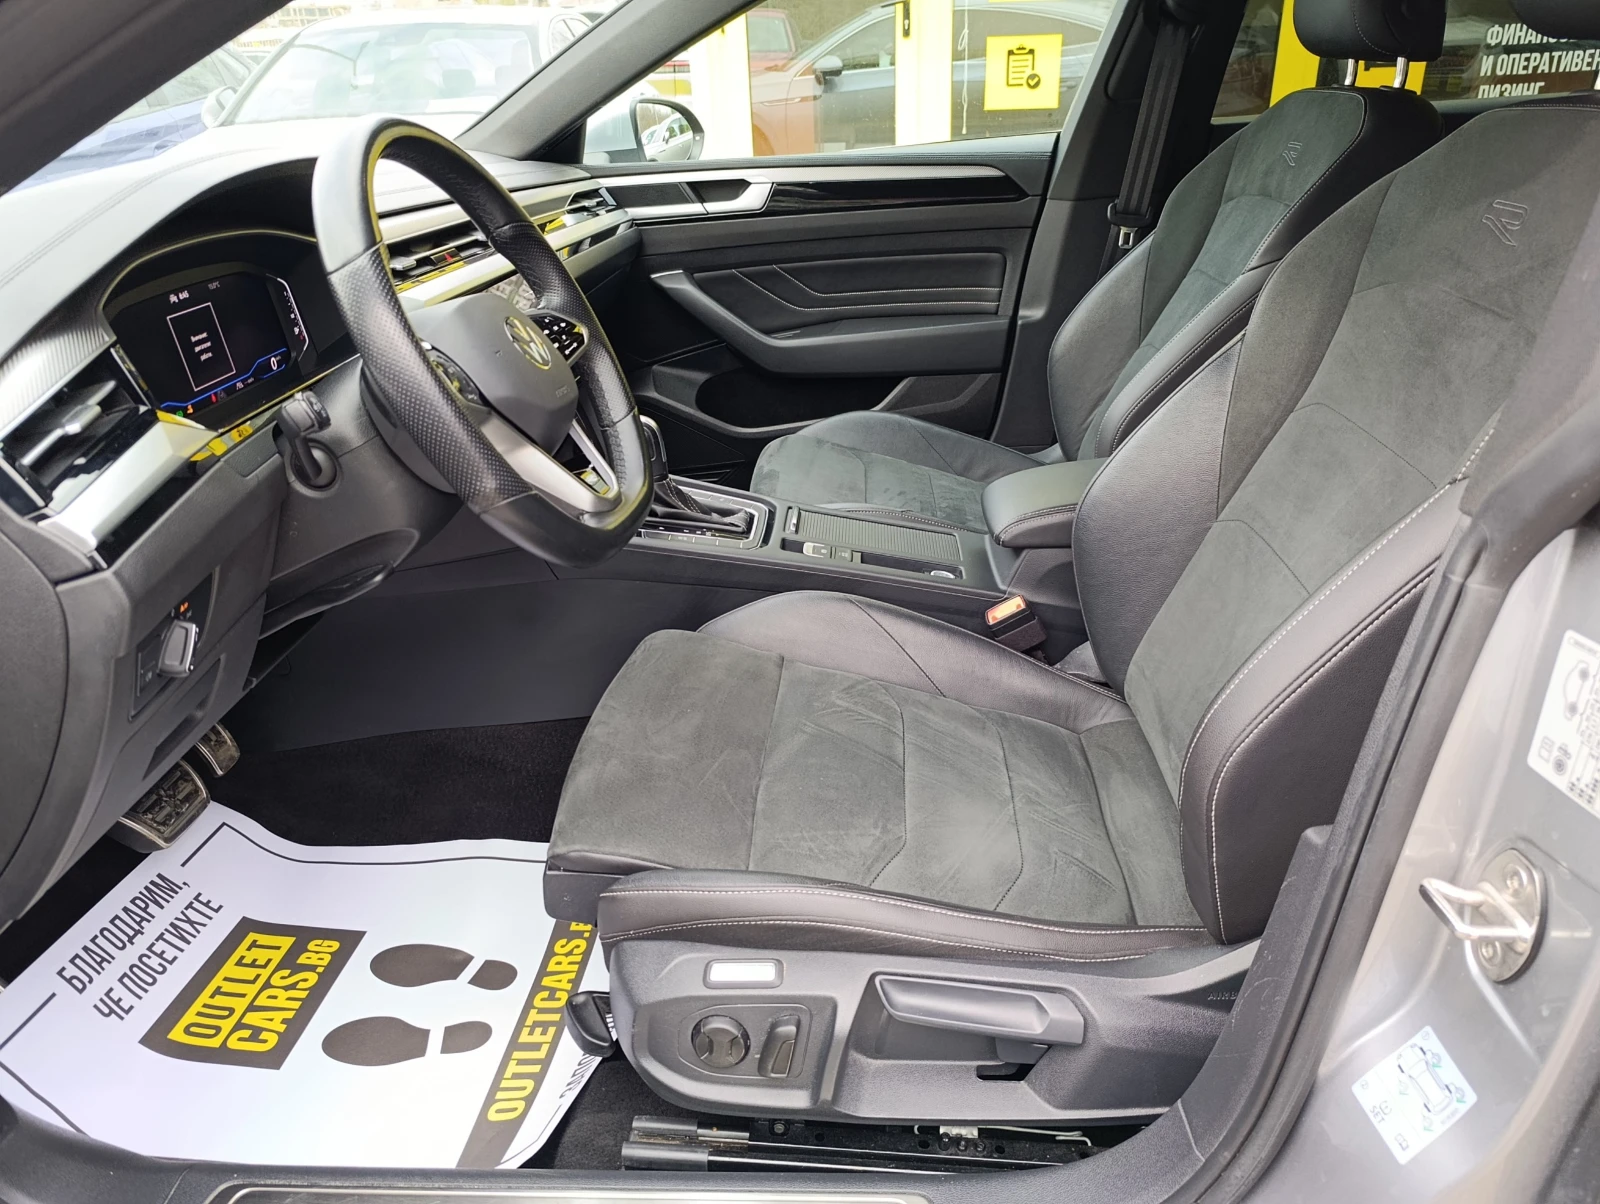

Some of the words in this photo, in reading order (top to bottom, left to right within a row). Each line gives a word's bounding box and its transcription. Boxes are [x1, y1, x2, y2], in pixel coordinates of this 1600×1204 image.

[1480, 55, 1494, 76] И
[56, 872, 191, 995] БЛАГОДАРИМ,
[92, 987, 135, 1021] ЧЕ
[117, 892, 224, 1001] ПОСЕТИХТЕ
[182, 938, 284, 1040] OUTLET
[226, 939, 341, 1053] CARS.BG
